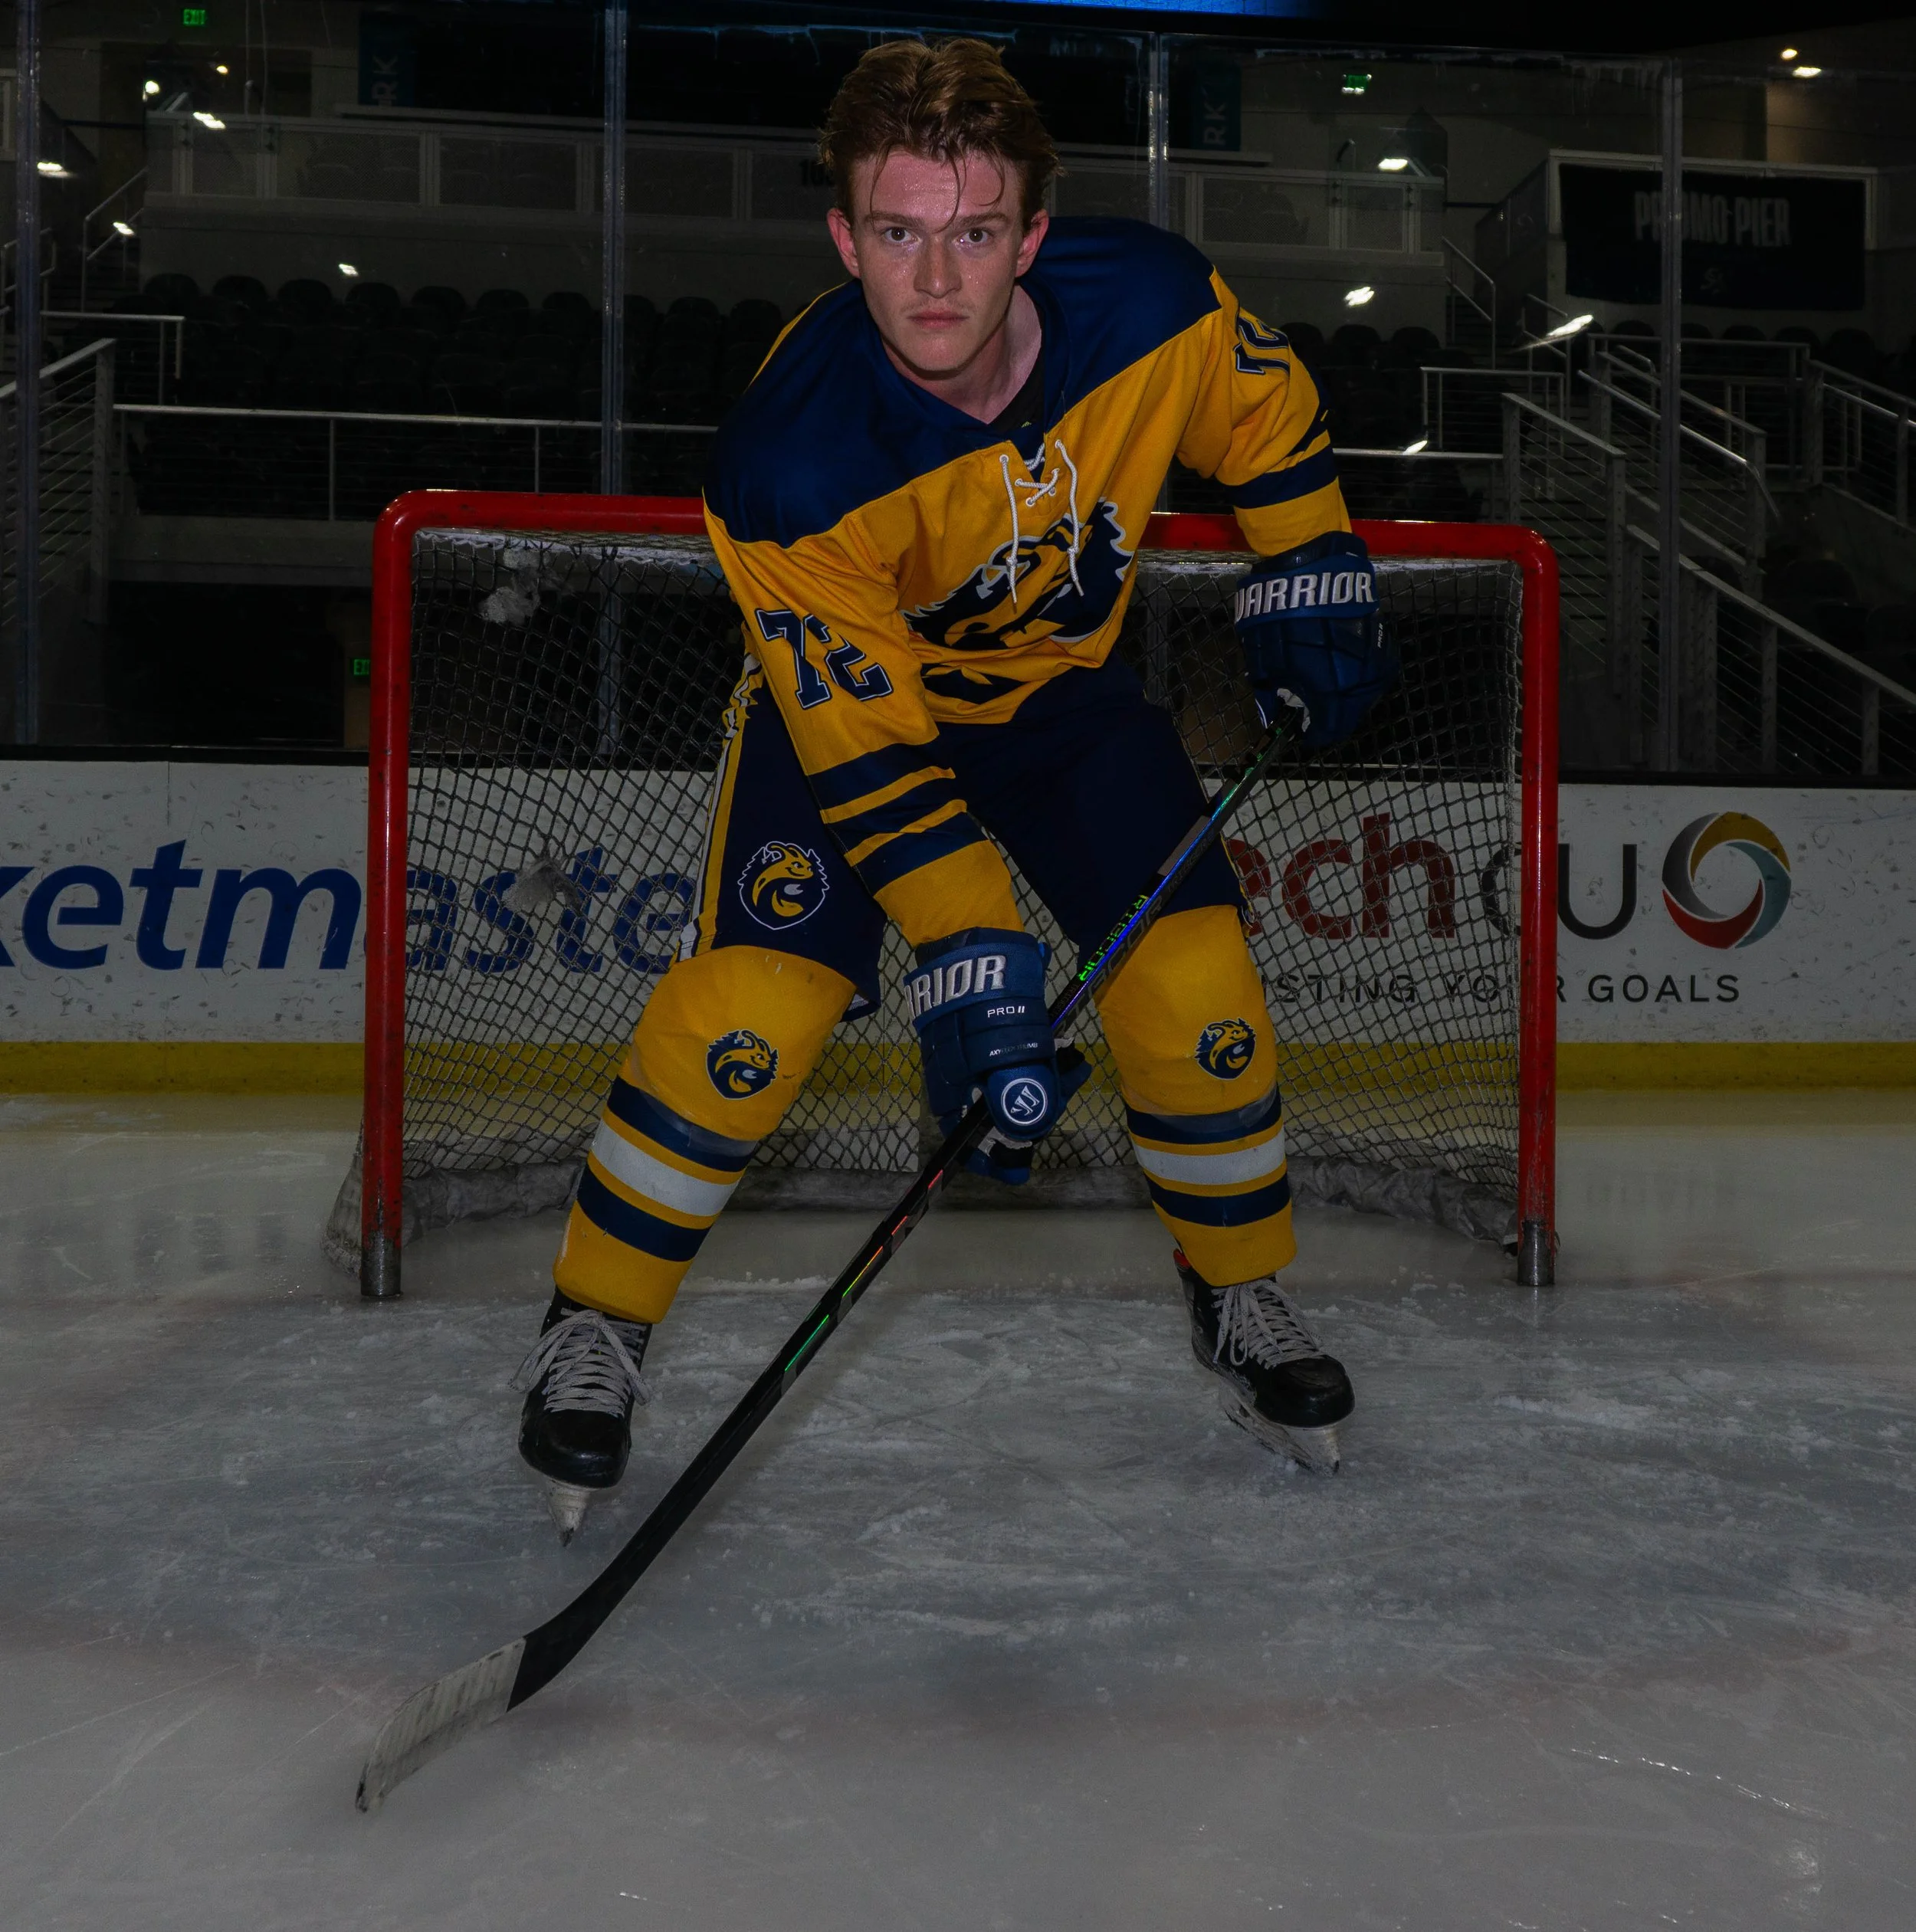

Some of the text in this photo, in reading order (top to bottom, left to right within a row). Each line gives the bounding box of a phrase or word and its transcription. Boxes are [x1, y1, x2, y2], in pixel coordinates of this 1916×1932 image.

[184, 8, 206, 25] EXIT
[1734, 196, 1792, 247] PIER
[754, 608, 894, 710] 72
[1261, 974, 1740, 1003] STING YOR GOALS
[987, 1006, 1015, 1018] PRO
